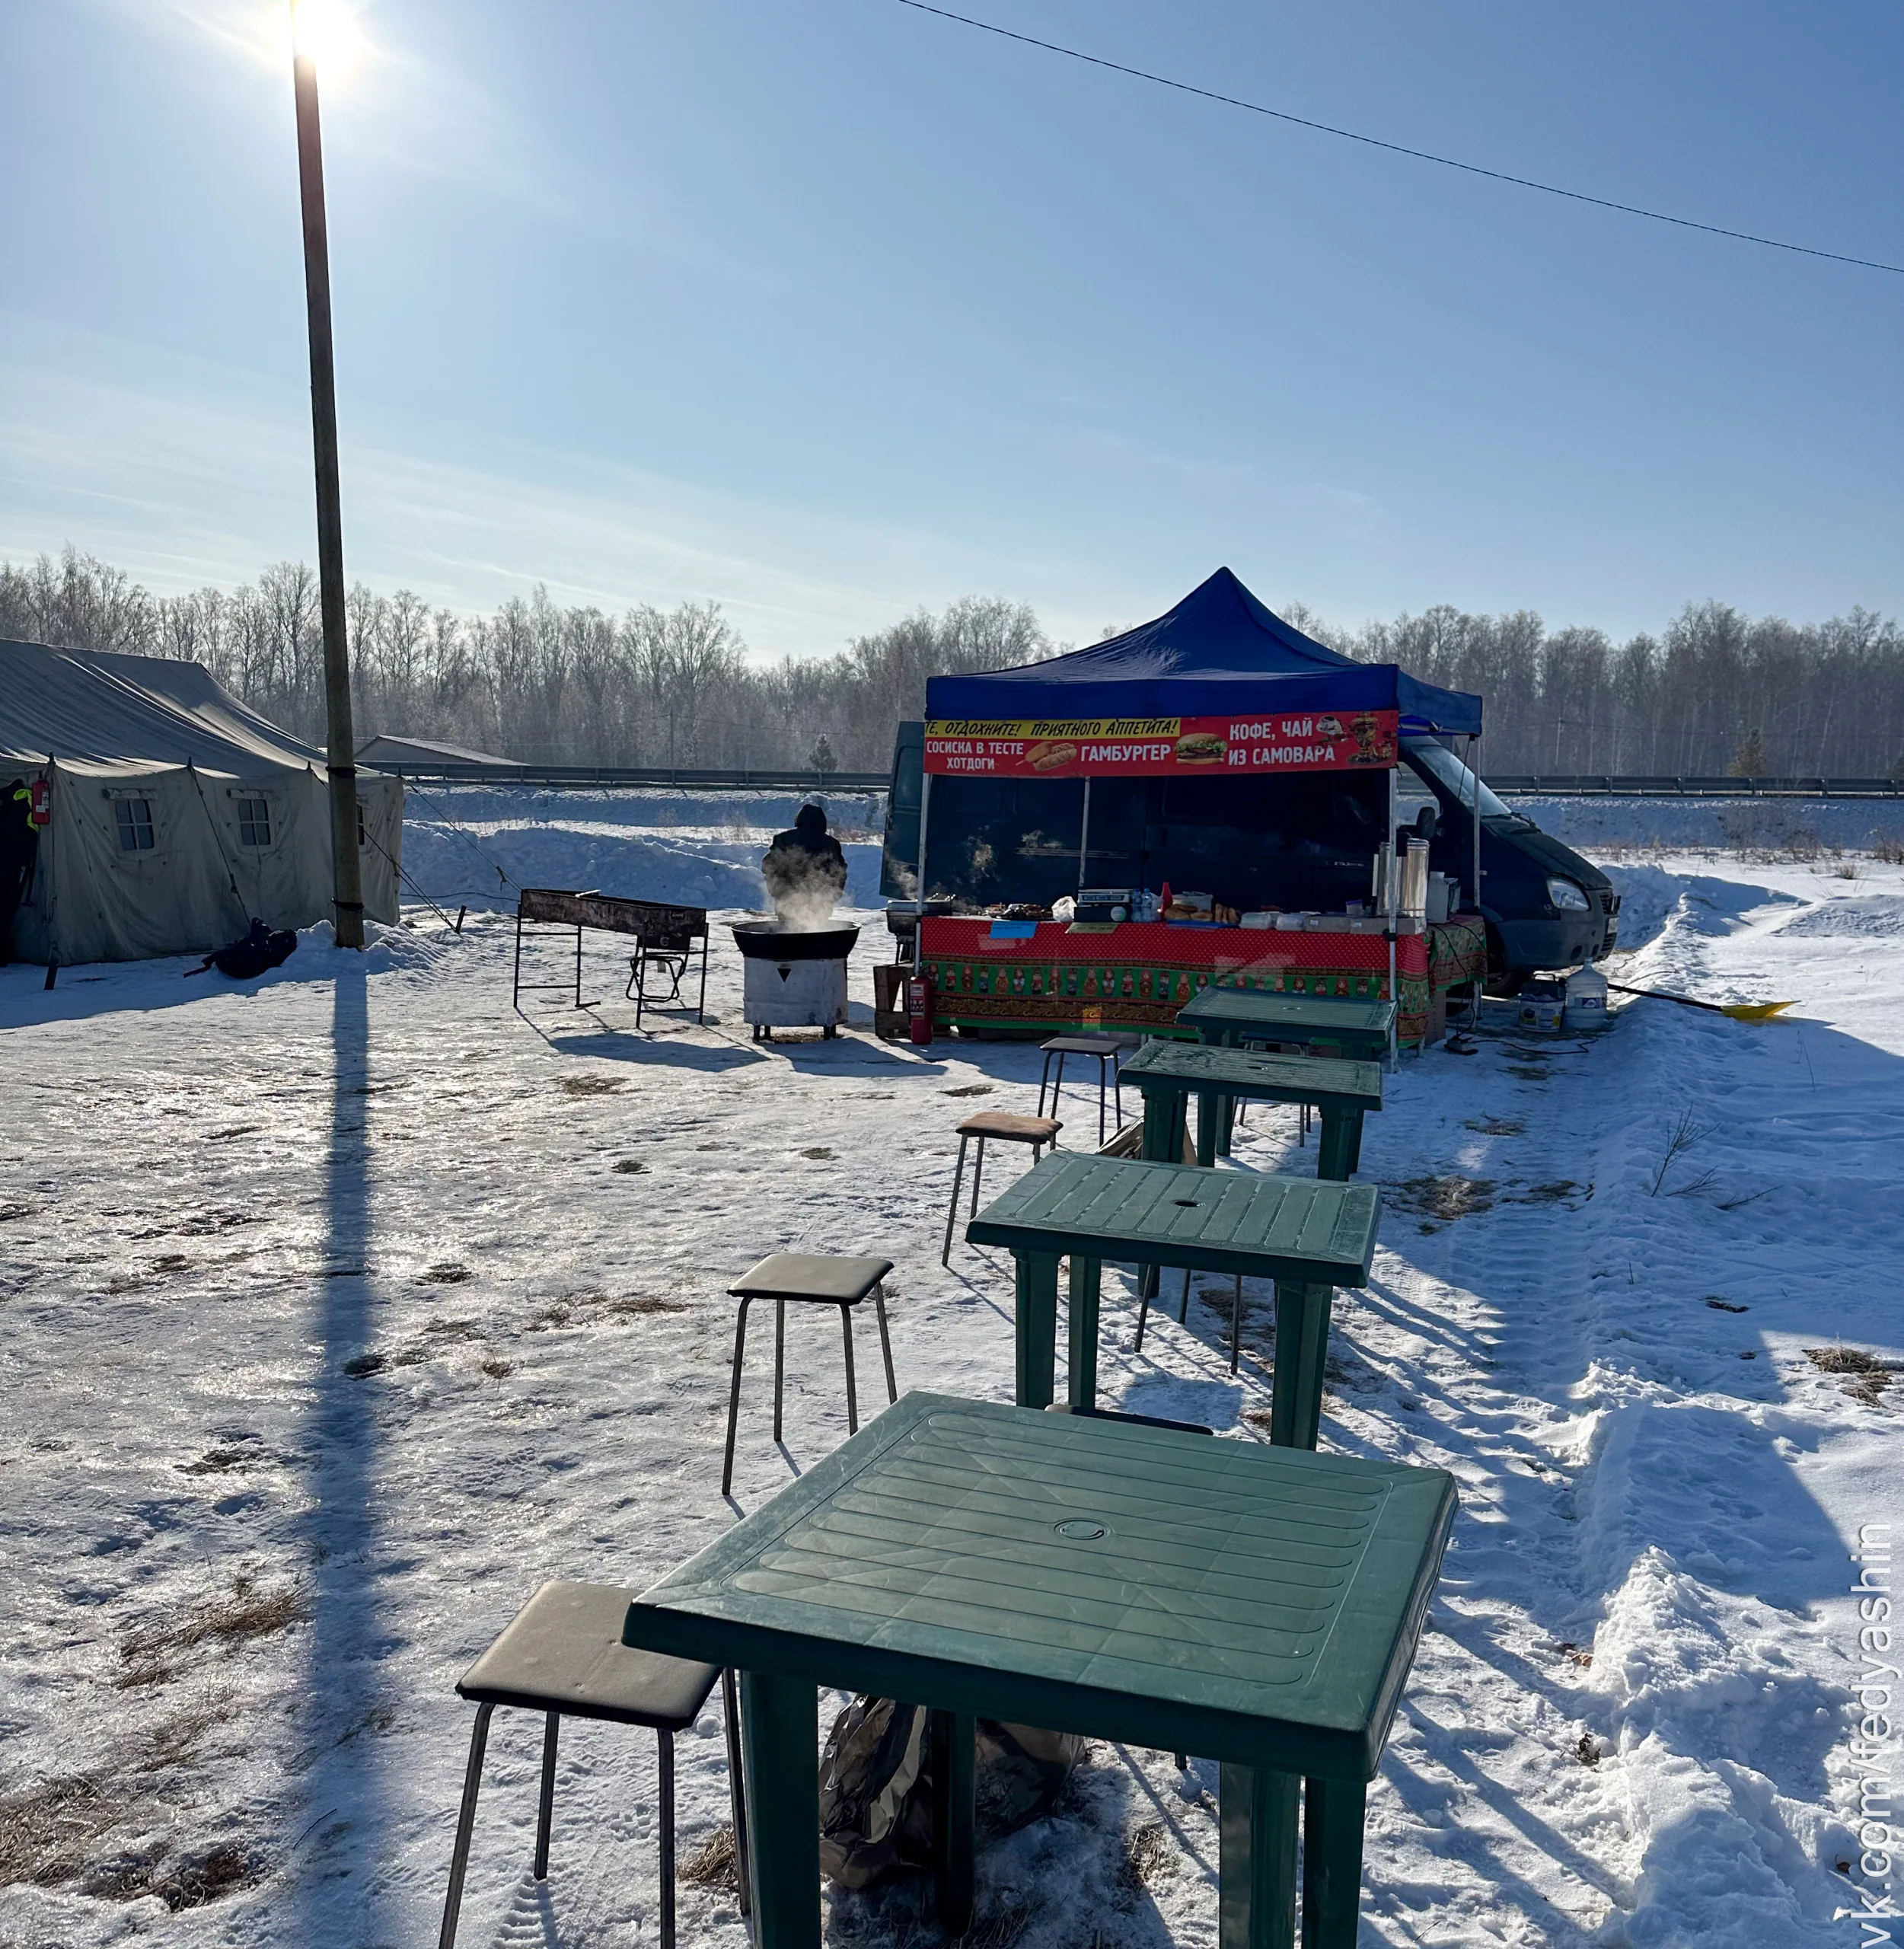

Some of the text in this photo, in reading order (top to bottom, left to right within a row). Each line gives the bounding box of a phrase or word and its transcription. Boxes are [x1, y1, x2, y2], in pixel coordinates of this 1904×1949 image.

[945, 722, 1022, 736] ОТДОХНИТЕ!
[1030, 722, 1101, 736] ПРИЯТНОГО
[1105, 719, 1178, 735] АППЕТИТА!
[1229, 717, 1312, 741] КОФЕ, ЧАЙ
[926, 741, 1024, 754] СОСИСКА В ТЕСТЕ
[1081, 744, 1171, 761] ГАМБУРГЕР
[1229, 745, 1335, 766] ИЗ САМОВАРА
[946, 757, 994, 770] ХОТДОГИ
